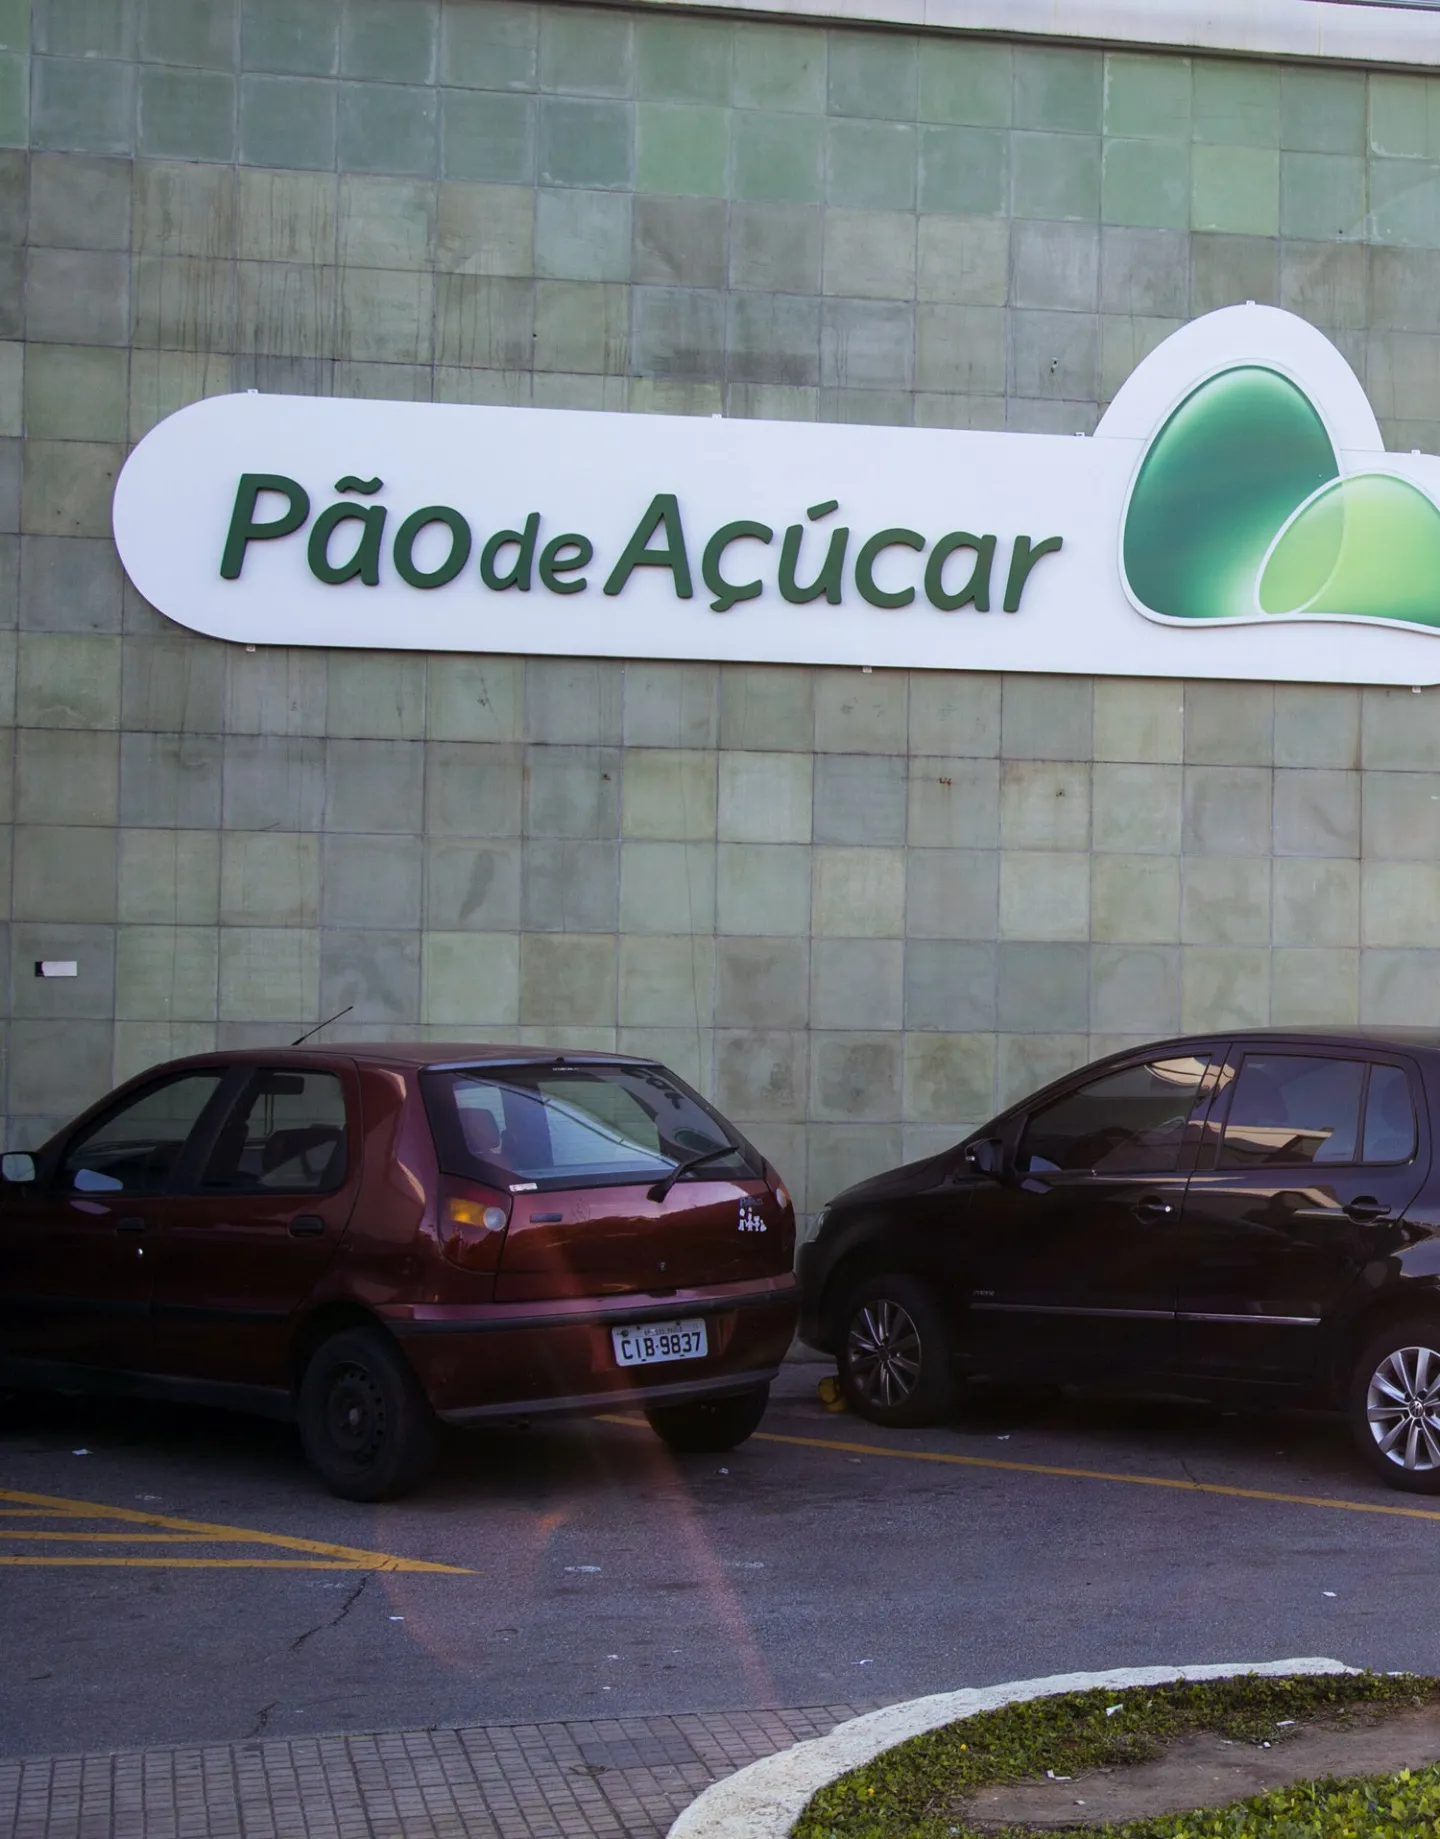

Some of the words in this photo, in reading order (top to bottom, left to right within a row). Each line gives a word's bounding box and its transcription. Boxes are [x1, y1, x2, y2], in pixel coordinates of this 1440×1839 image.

[220, 473, 473, 590] Pão
[480, 512, 594, 596] de
[603, 494, 1064, 614] Açúcar
